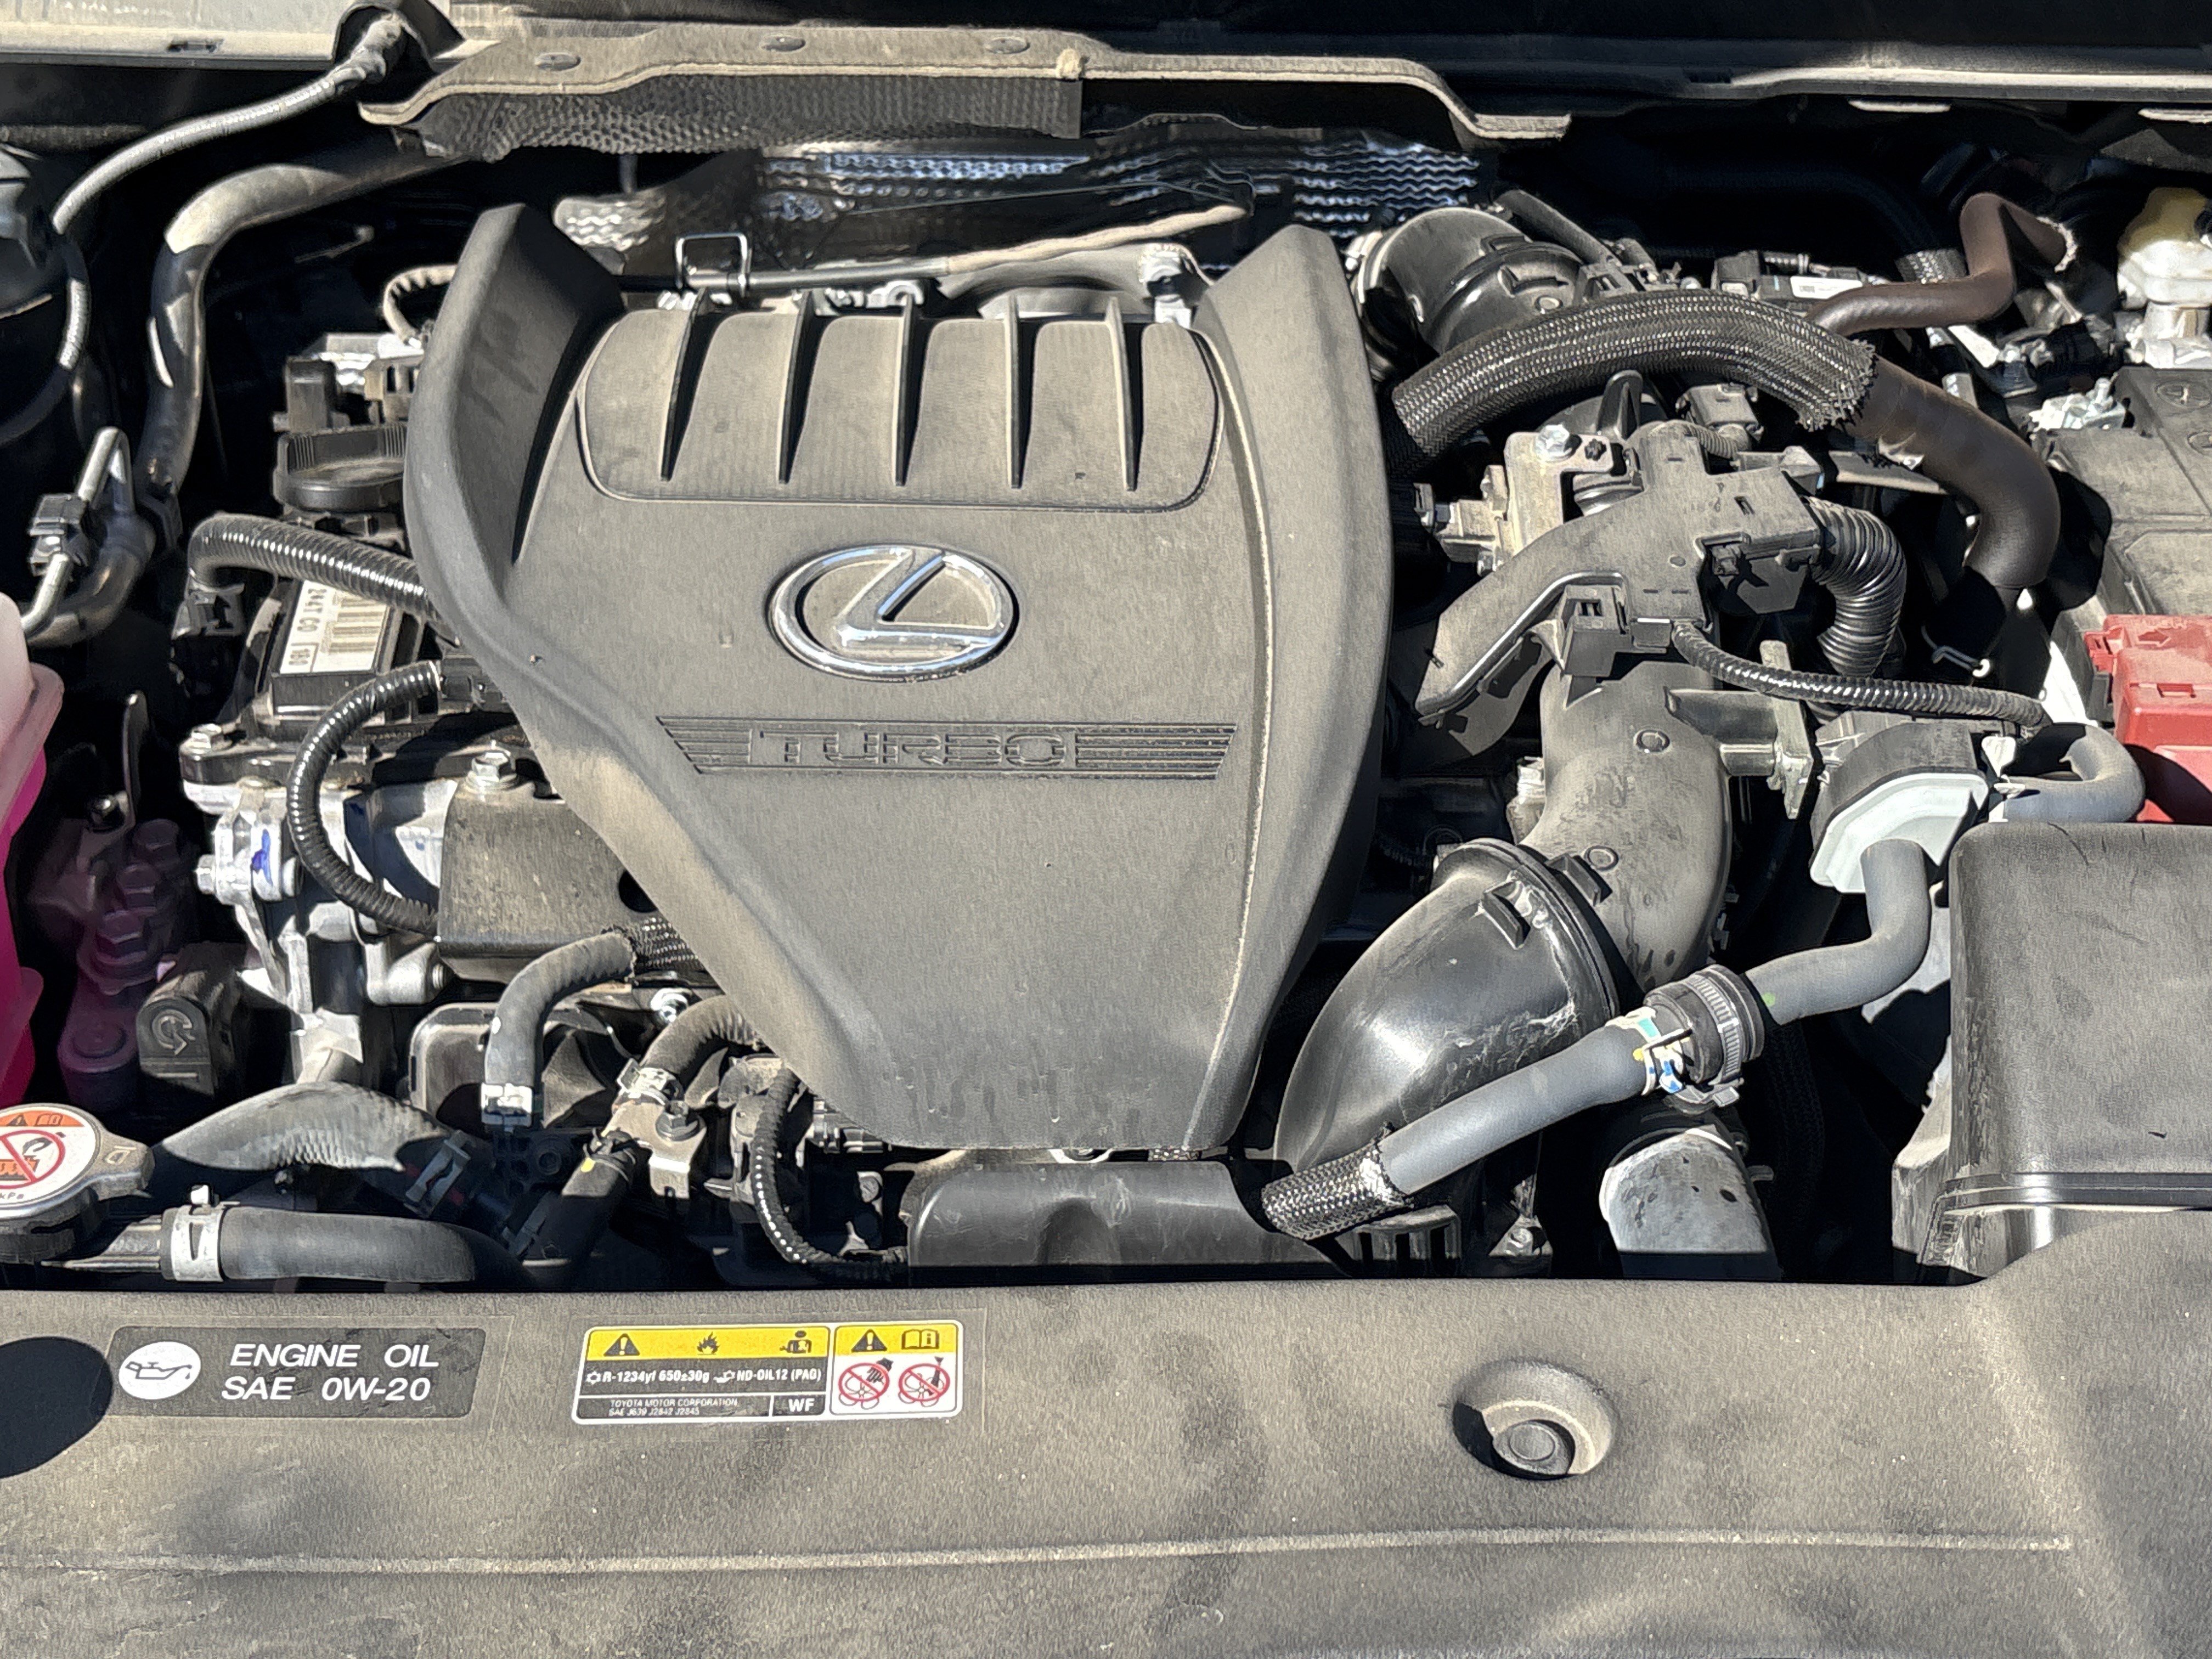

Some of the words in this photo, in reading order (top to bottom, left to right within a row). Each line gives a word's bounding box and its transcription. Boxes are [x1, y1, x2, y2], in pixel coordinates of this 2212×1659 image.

[759, 732, 1065, 766] TURBO
[230, 1344, 362, 1367] ENGINE
[384, 1344, 439, 1368] OIL
[602, 1370, 657, 1384] R-1234yf
[658, 1370, 710, 1384] 650±30g
[736, 1368, 788, 1381] ND-OIL12
[791, 1368, 822, 1382] (PAG)
[221, 1376, 296, 1400] SAE
[321, 1377, 431, 1401] 0W-20
[611, 1400, 643, 1408] TOYOTA
[645, 1399, 675, 1407] MOTOR
[677, 1398, 738, 1407] CORPORATION
[788, 1398, 815, 1412] WF
